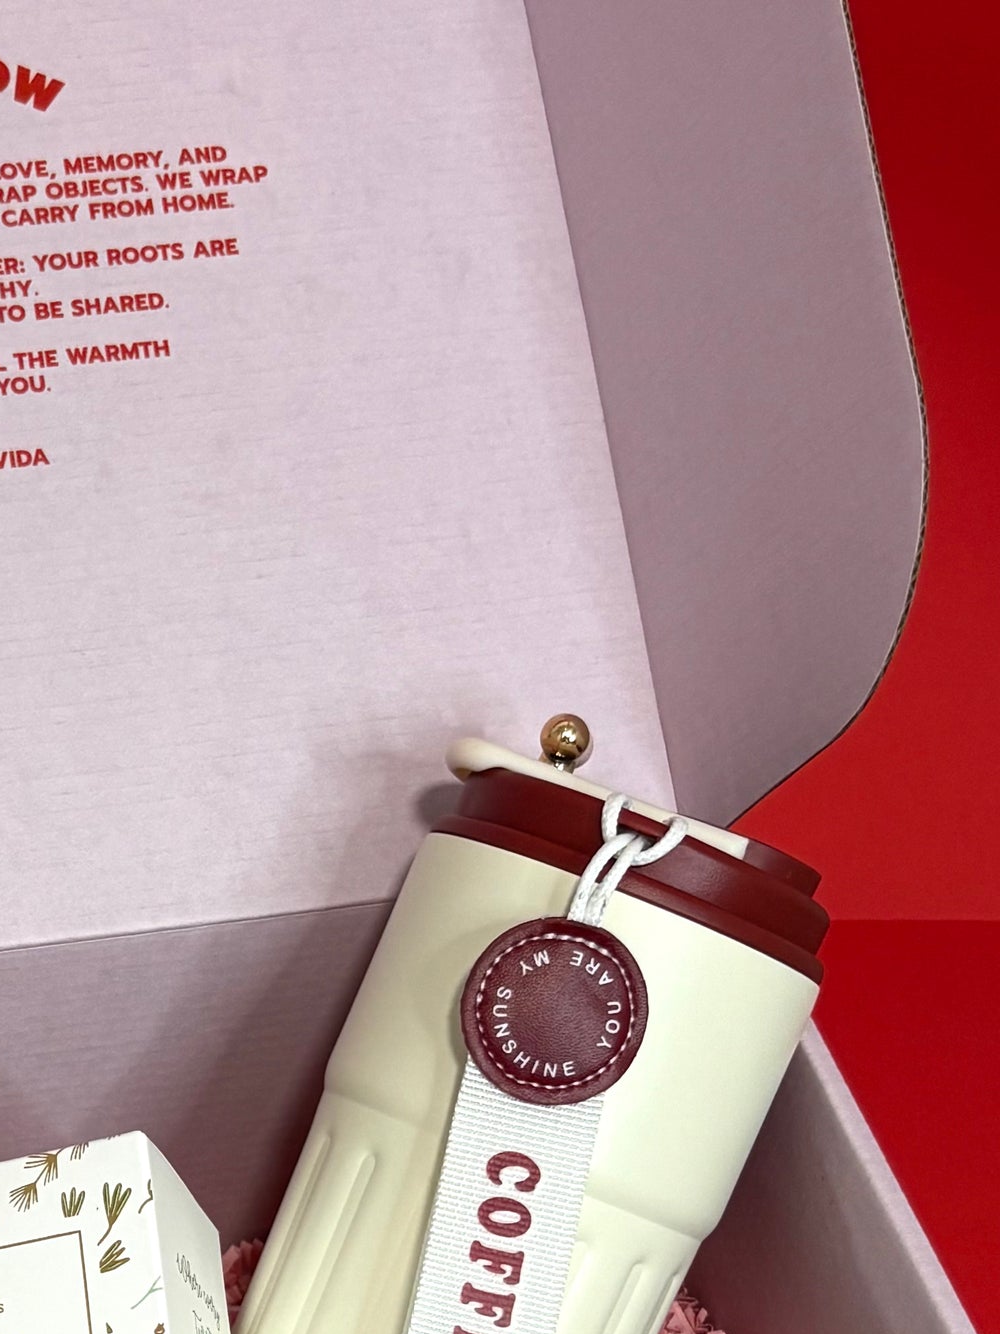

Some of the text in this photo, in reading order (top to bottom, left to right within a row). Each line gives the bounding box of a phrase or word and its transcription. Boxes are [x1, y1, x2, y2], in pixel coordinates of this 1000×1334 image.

[63, 151, 168, 175] MEMORY,
[179, 145, 227, 165] AND
[45, 175, 148, 200] OBJECTS.
[156, 171, 191, 190] WE
[200, 165, 267, 187] WRAP
[1, 204, 78, 227] CARRY
[88, 198, 154, 220] FROM
[162, 192, 234, 213] HOME.
[33, 250, 98, 271] YOUR
[106, 243, 184, 266] ROOTS
[194, 238, 238, 258] ARE
[34, 301, 63, 320] BE
[72, 293, 169, 316] SHARED.
[13, 350, 58, 370] THE
[66, 340, 170, 365] WARMTH
[493, 949, 622, 1078] YOU ARE MY SUNSHINE
